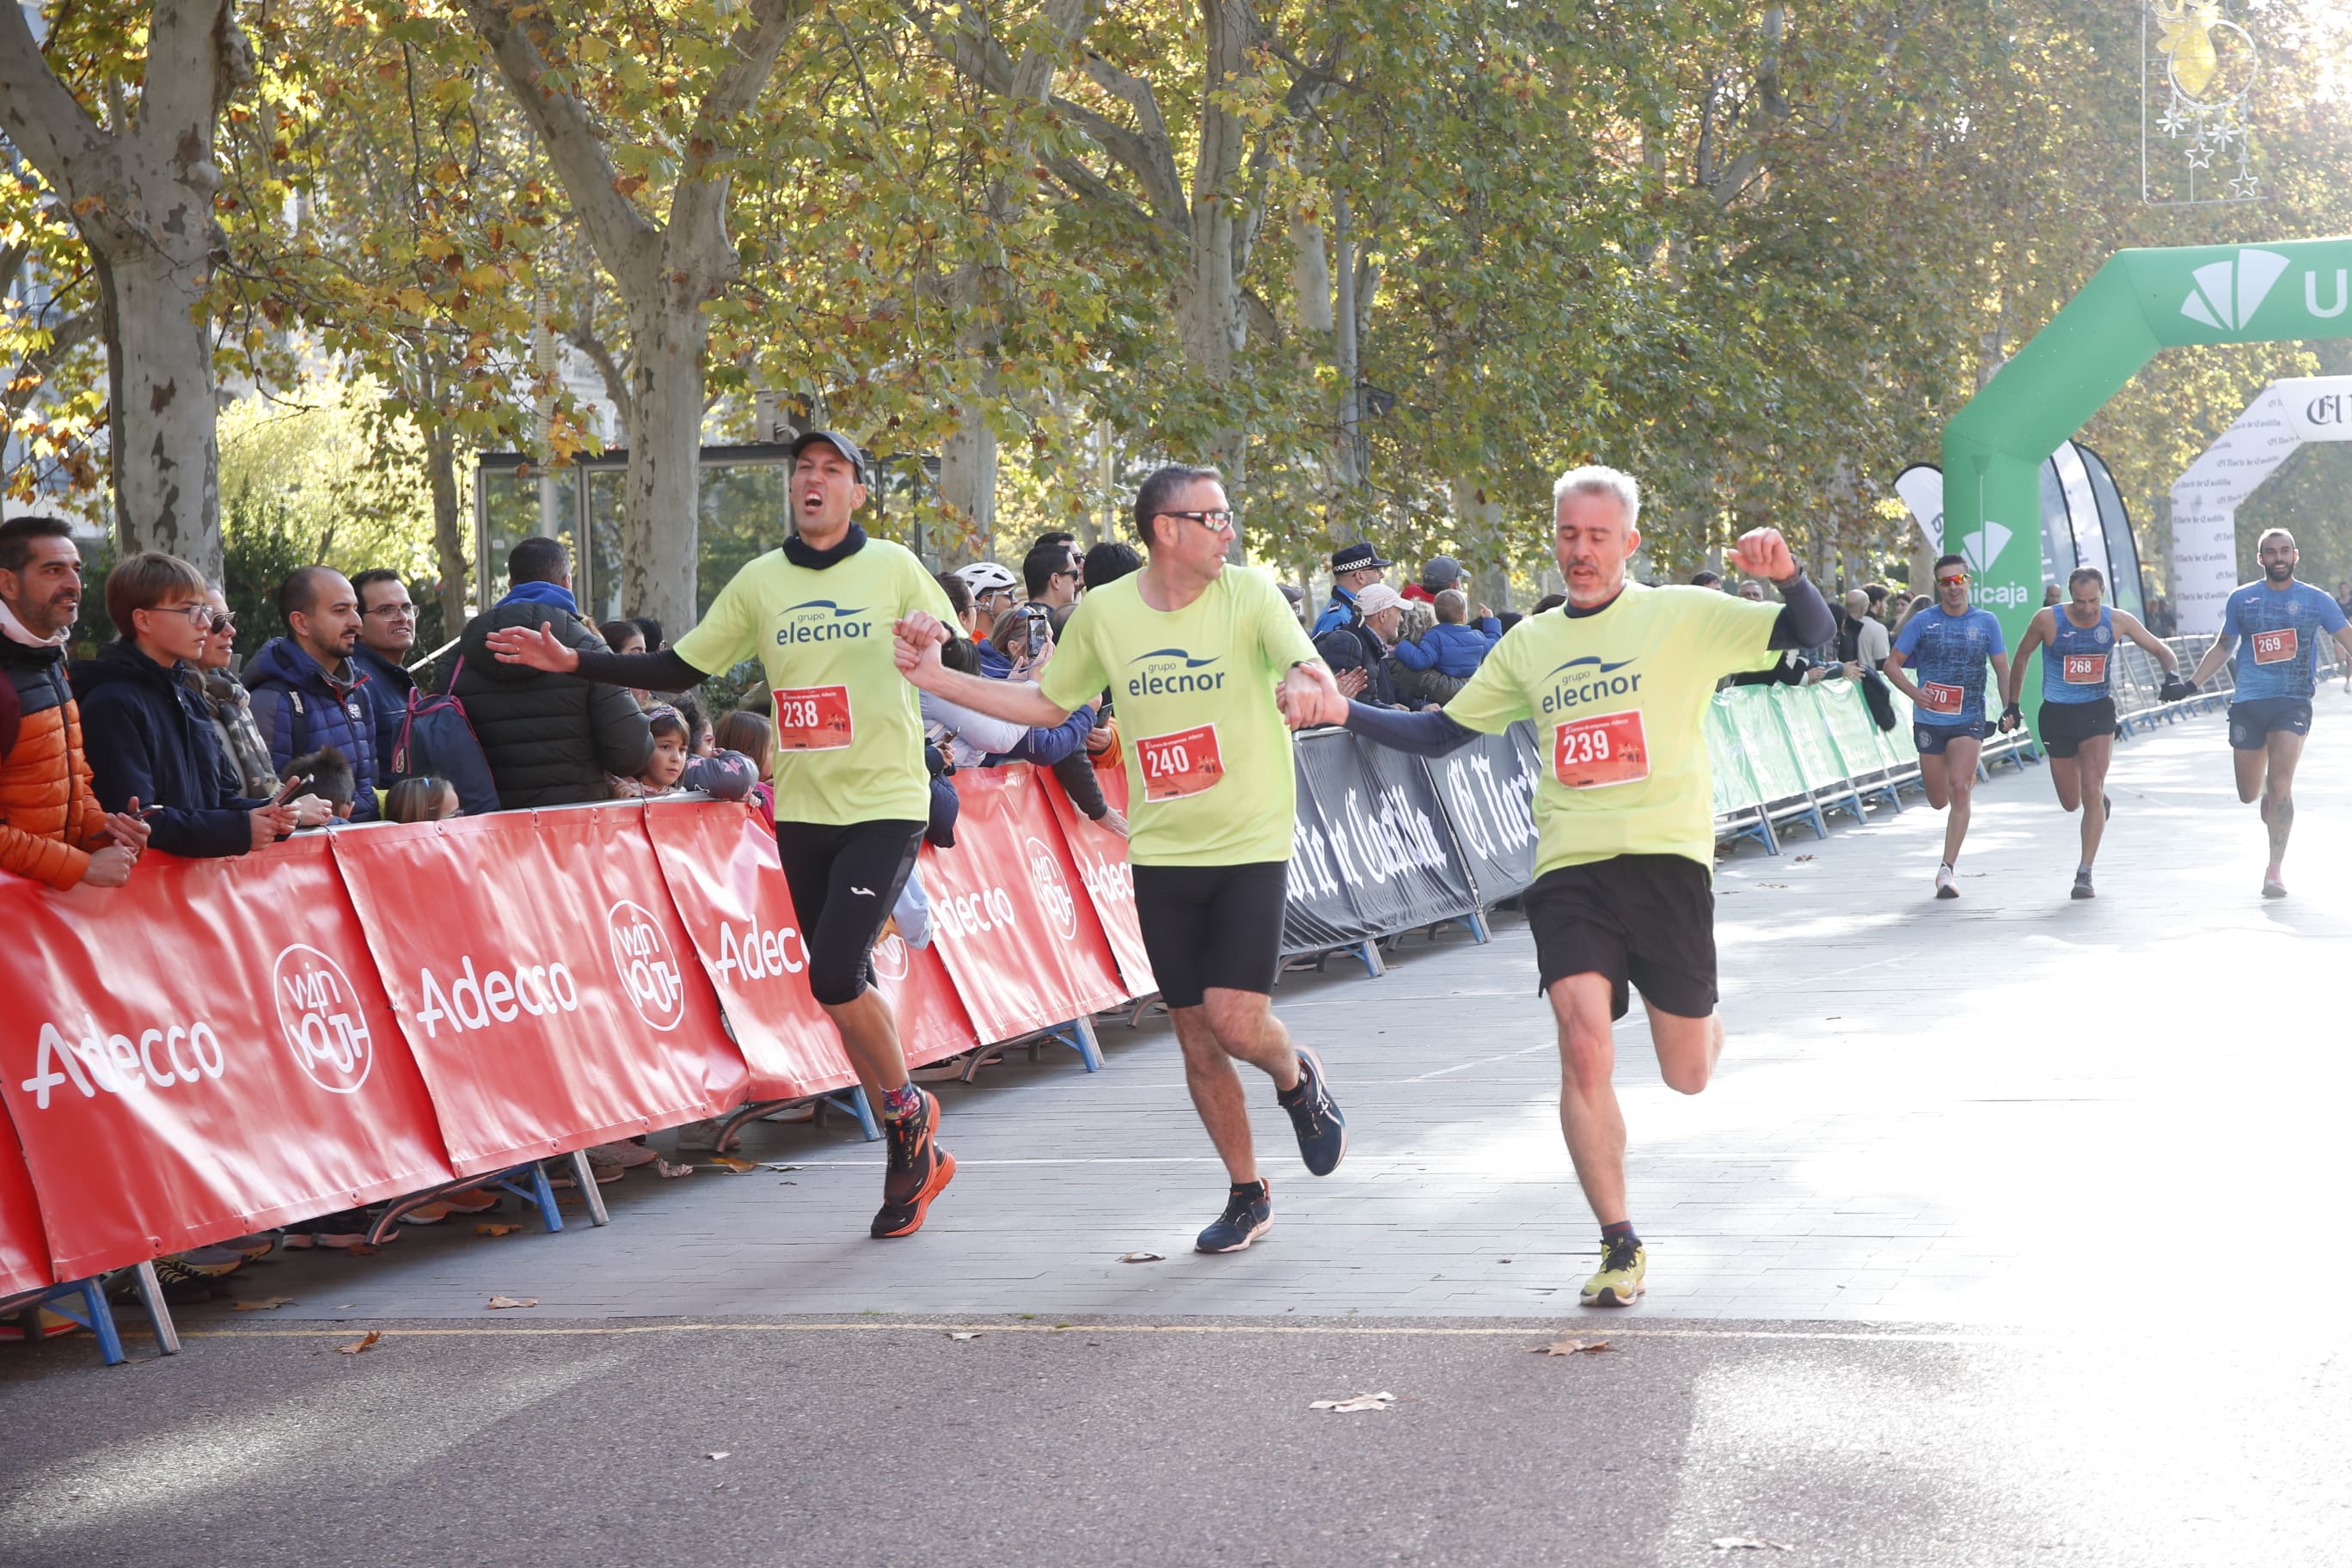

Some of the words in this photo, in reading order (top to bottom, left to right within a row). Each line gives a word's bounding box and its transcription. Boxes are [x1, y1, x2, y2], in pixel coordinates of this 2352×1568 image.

[1968, 581, 2029, 609] icaja
[798, 613, 825, 623] grupo
[776, 622, 872, 646] elecnor
[2258, 637, 2281, 653] 269
[1148, 663, 1177, 674] grupo
[1562, 671, 1590, 686] grupo
[2069, 660, 2092, 673] 268
[1129, 671, 1225, 696] elecnor
[1542, 673, 1642, 714] elecnor
[1933, 689, 1947, 703] 70
[783, 700, 818, 728] 238
[1563, 729, 1610, 765] 239
[1147, 744, 1190, 778] 240
[1085, 850, 1135, 903] Adec
[416, 955, 578, 1038] Adecco
[21, 1014, 224, 1110] Adecco
